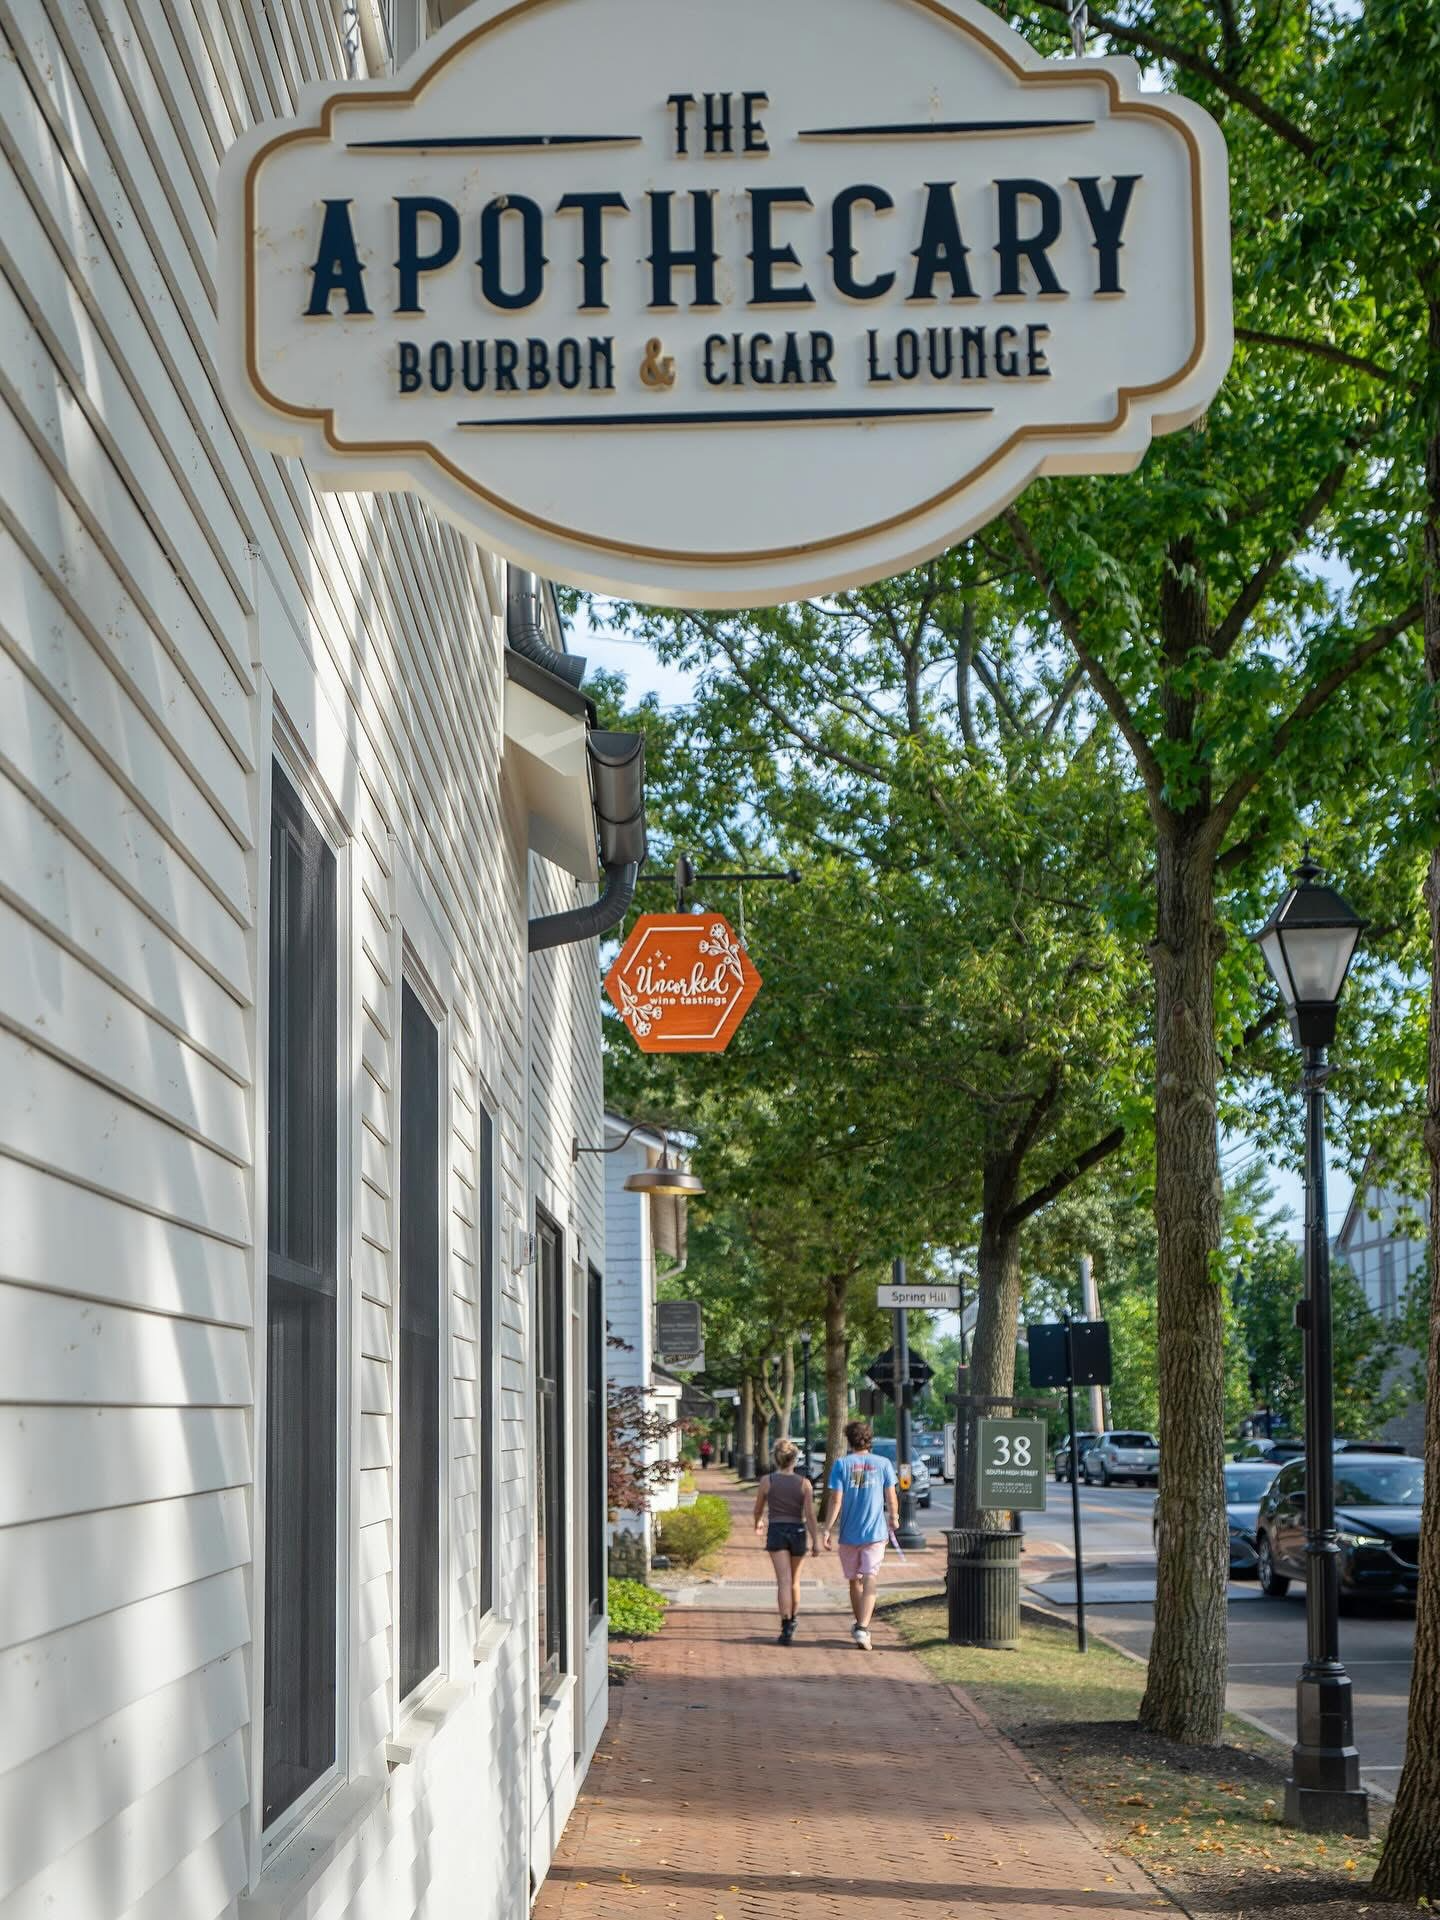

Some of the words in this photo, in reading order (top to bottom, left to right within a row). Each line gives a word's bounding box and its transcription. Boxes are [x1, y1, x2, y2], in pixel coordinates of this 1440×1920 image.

[666, 91, 771, 156] THE
[302, 174, 1144, 318] APOTHECARY
[397, 336, 616, 394] BOURBON
[638, 337, 677, 388] &
[703, 330, 838, 386] CIGAR
[866, 323, 1053, 383] LOUNGE
[636, 962, 730, 997] Uncorked
[650, 996, 676, 1005] wine
[680, 995, 727, 1007] tastings
[891, 1291, 926, 1304] Spring
[929, 1291, 947, 1303] Hill
[992, 1435, 1032, 1467] 38
